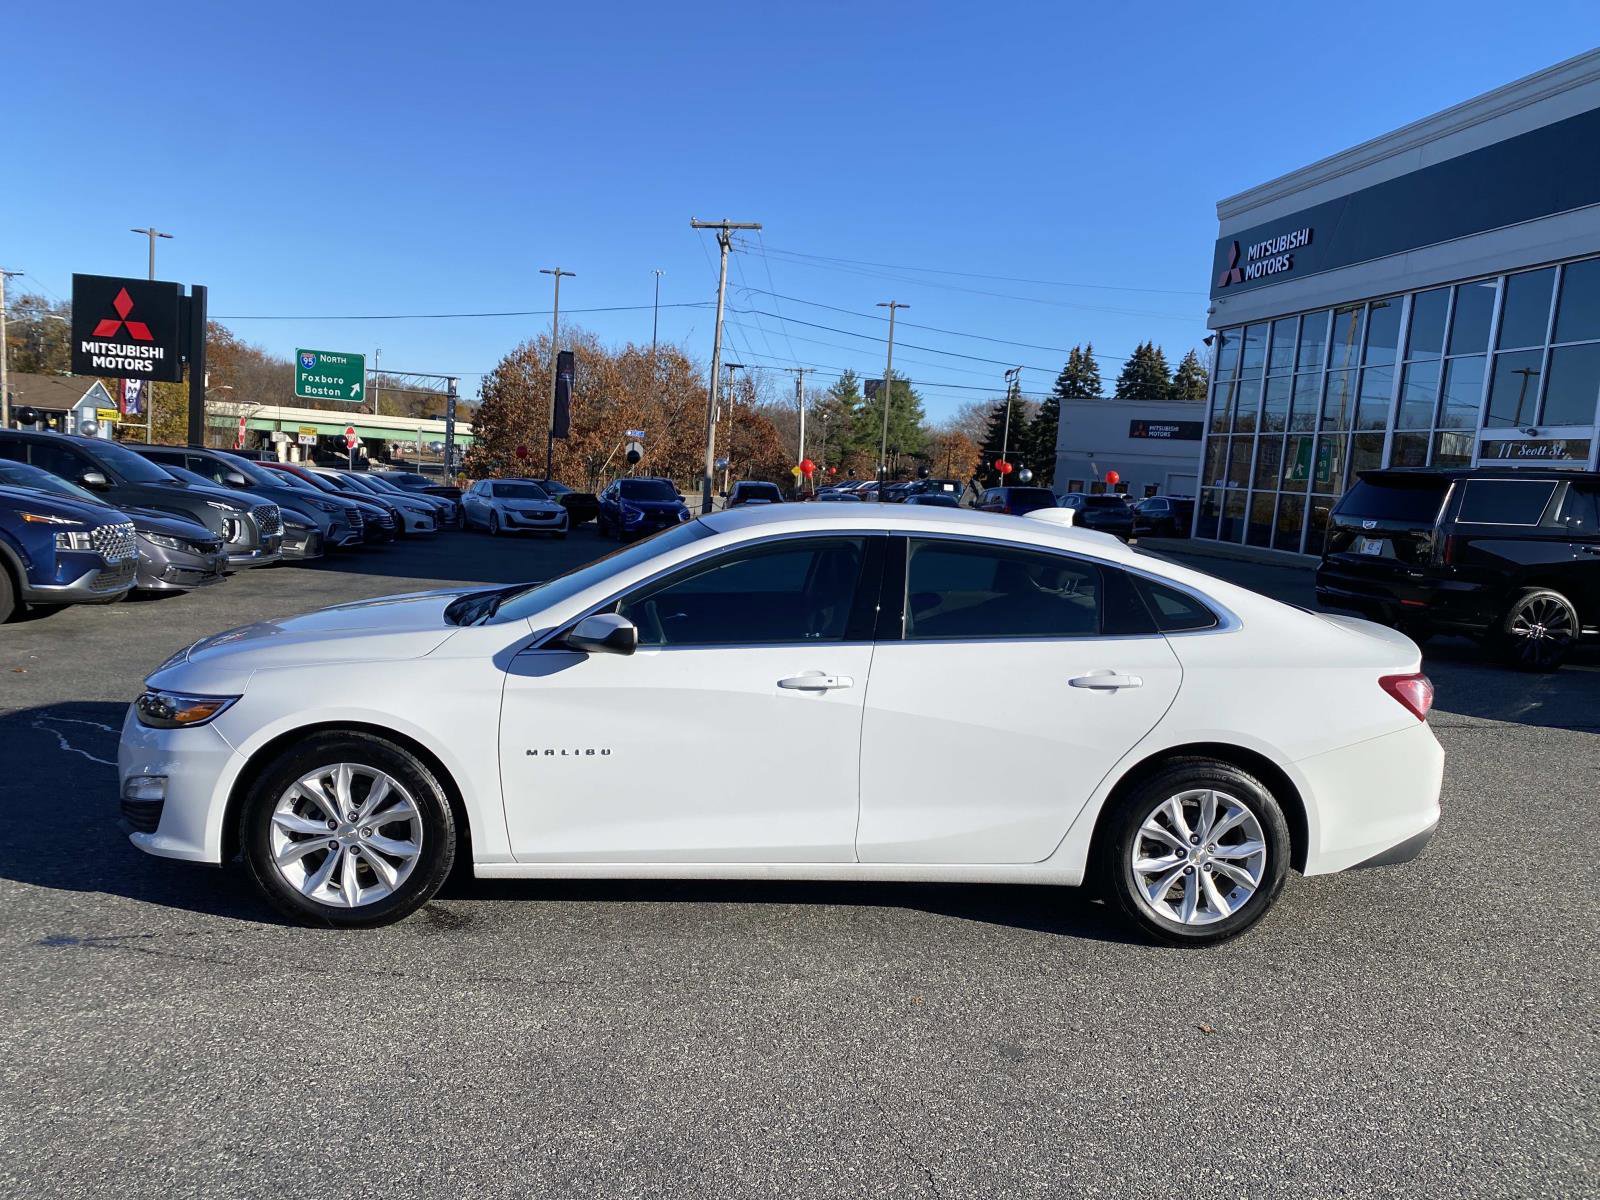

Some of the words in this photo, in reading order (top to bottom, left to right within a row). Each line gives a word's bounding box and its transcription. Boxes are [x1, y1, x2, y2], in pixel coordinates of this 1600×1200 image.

[1248, 228, 1309, 260] MITSUBISHI
[1245, 254, 1290, 280] MOTORS
[81, 341, 164, 359] MITSUBISHI
[92, 356, 154, 371] MOTORS
[303, 357, 313, 366] 95
[301, 373, 344, 385] Foxboro
[304, 385, 341, 396] Boston
[1518, 444, 1547, 456] Scott
[1549, 445, 1565, 456] St.
